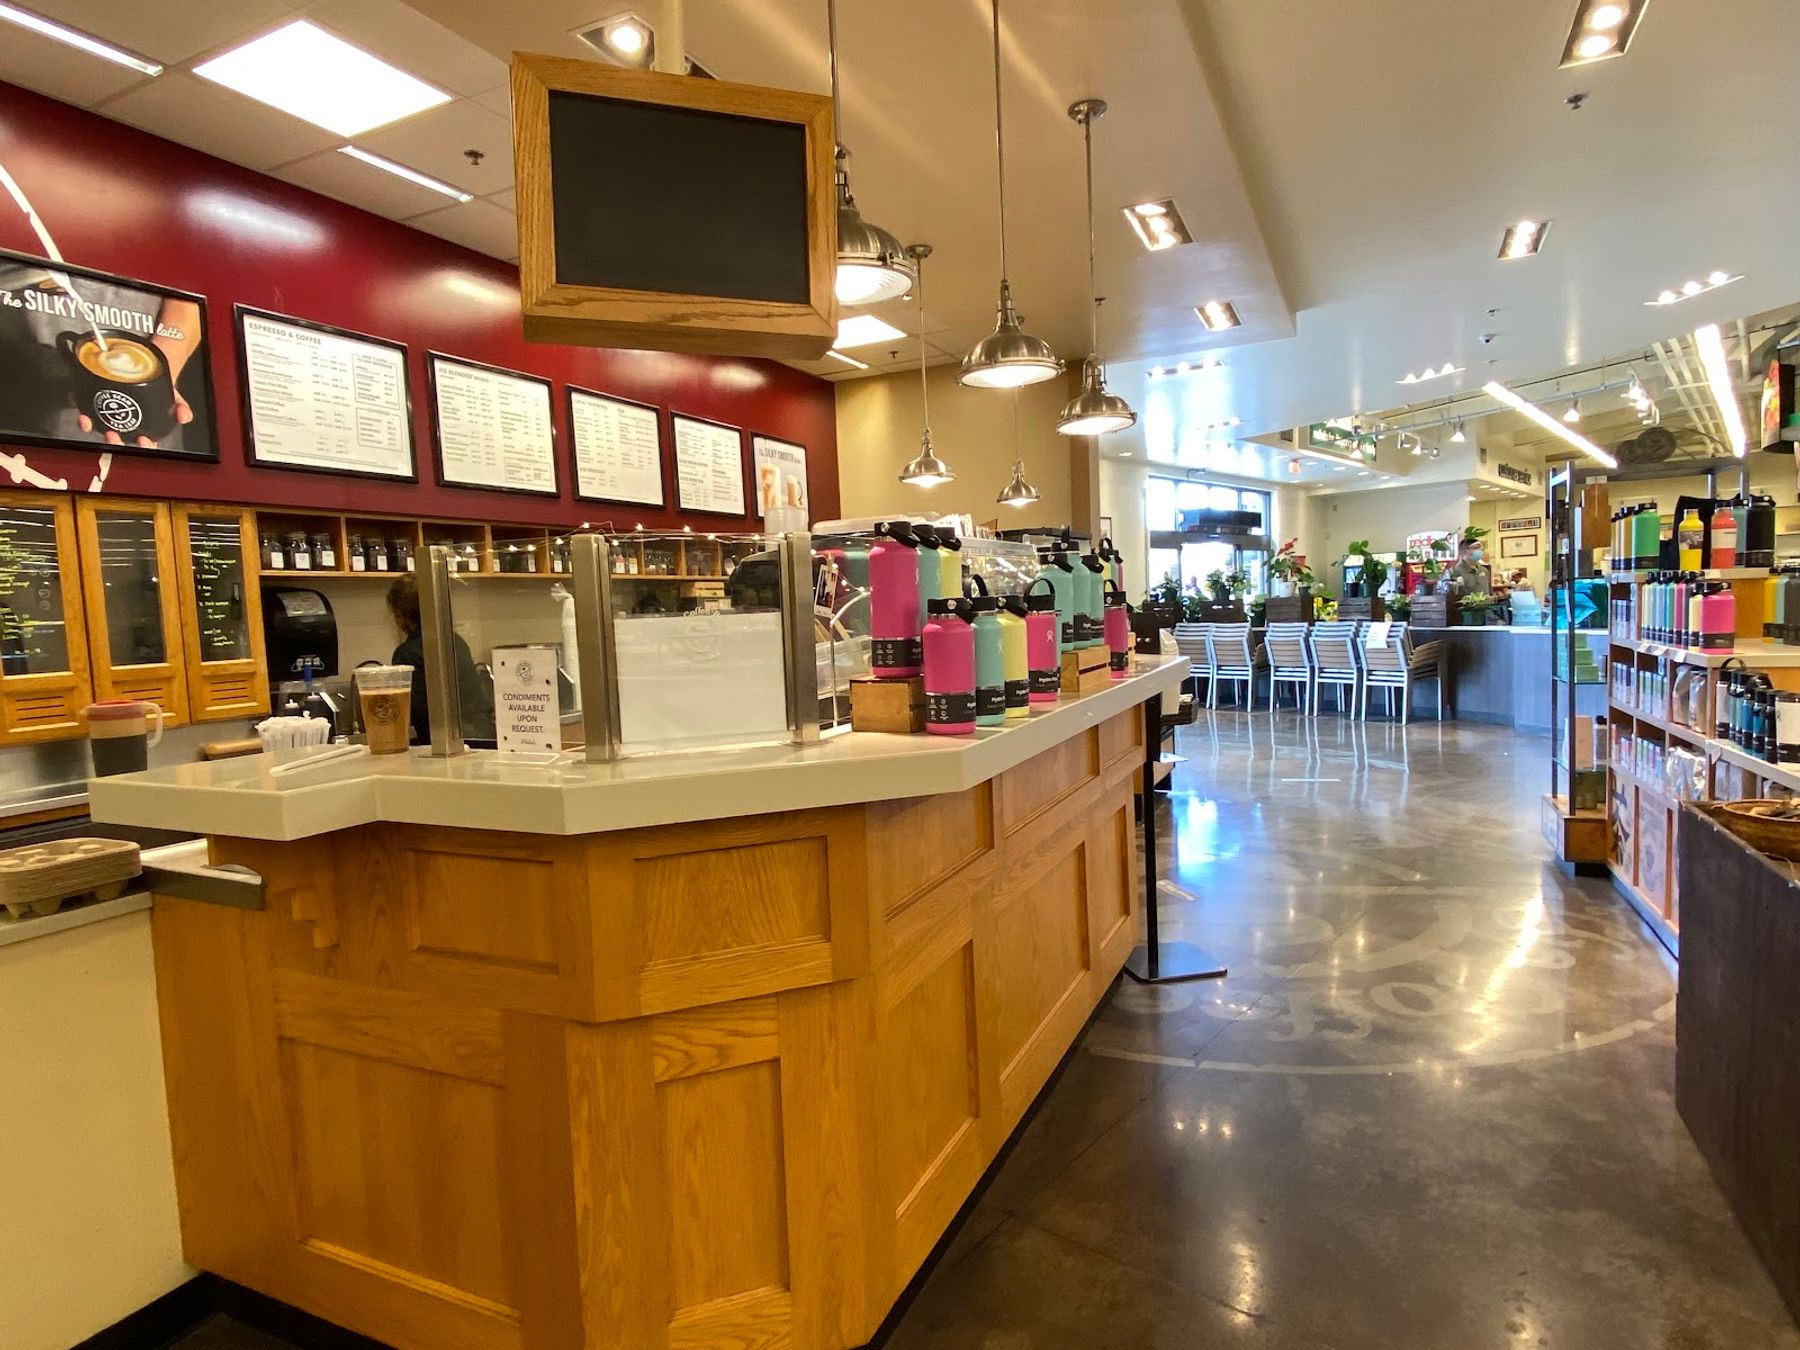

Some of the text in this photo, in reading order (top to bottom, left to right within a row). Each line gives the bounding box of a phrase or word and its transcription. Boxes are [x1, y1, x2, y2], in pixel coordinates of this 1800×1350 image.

[24, 289, 77, 318] SILKY
[83, 301, 154, 334] SMOOTH
[156, 322, 185, 340] latte
[248, 322, 287, 337] ESPRESSO
[295, 333, 322, 345] COFFEE
[502, 693, 550, 702] CONDIMENTS
[508, 704, 545, 712] AVAILABLE
